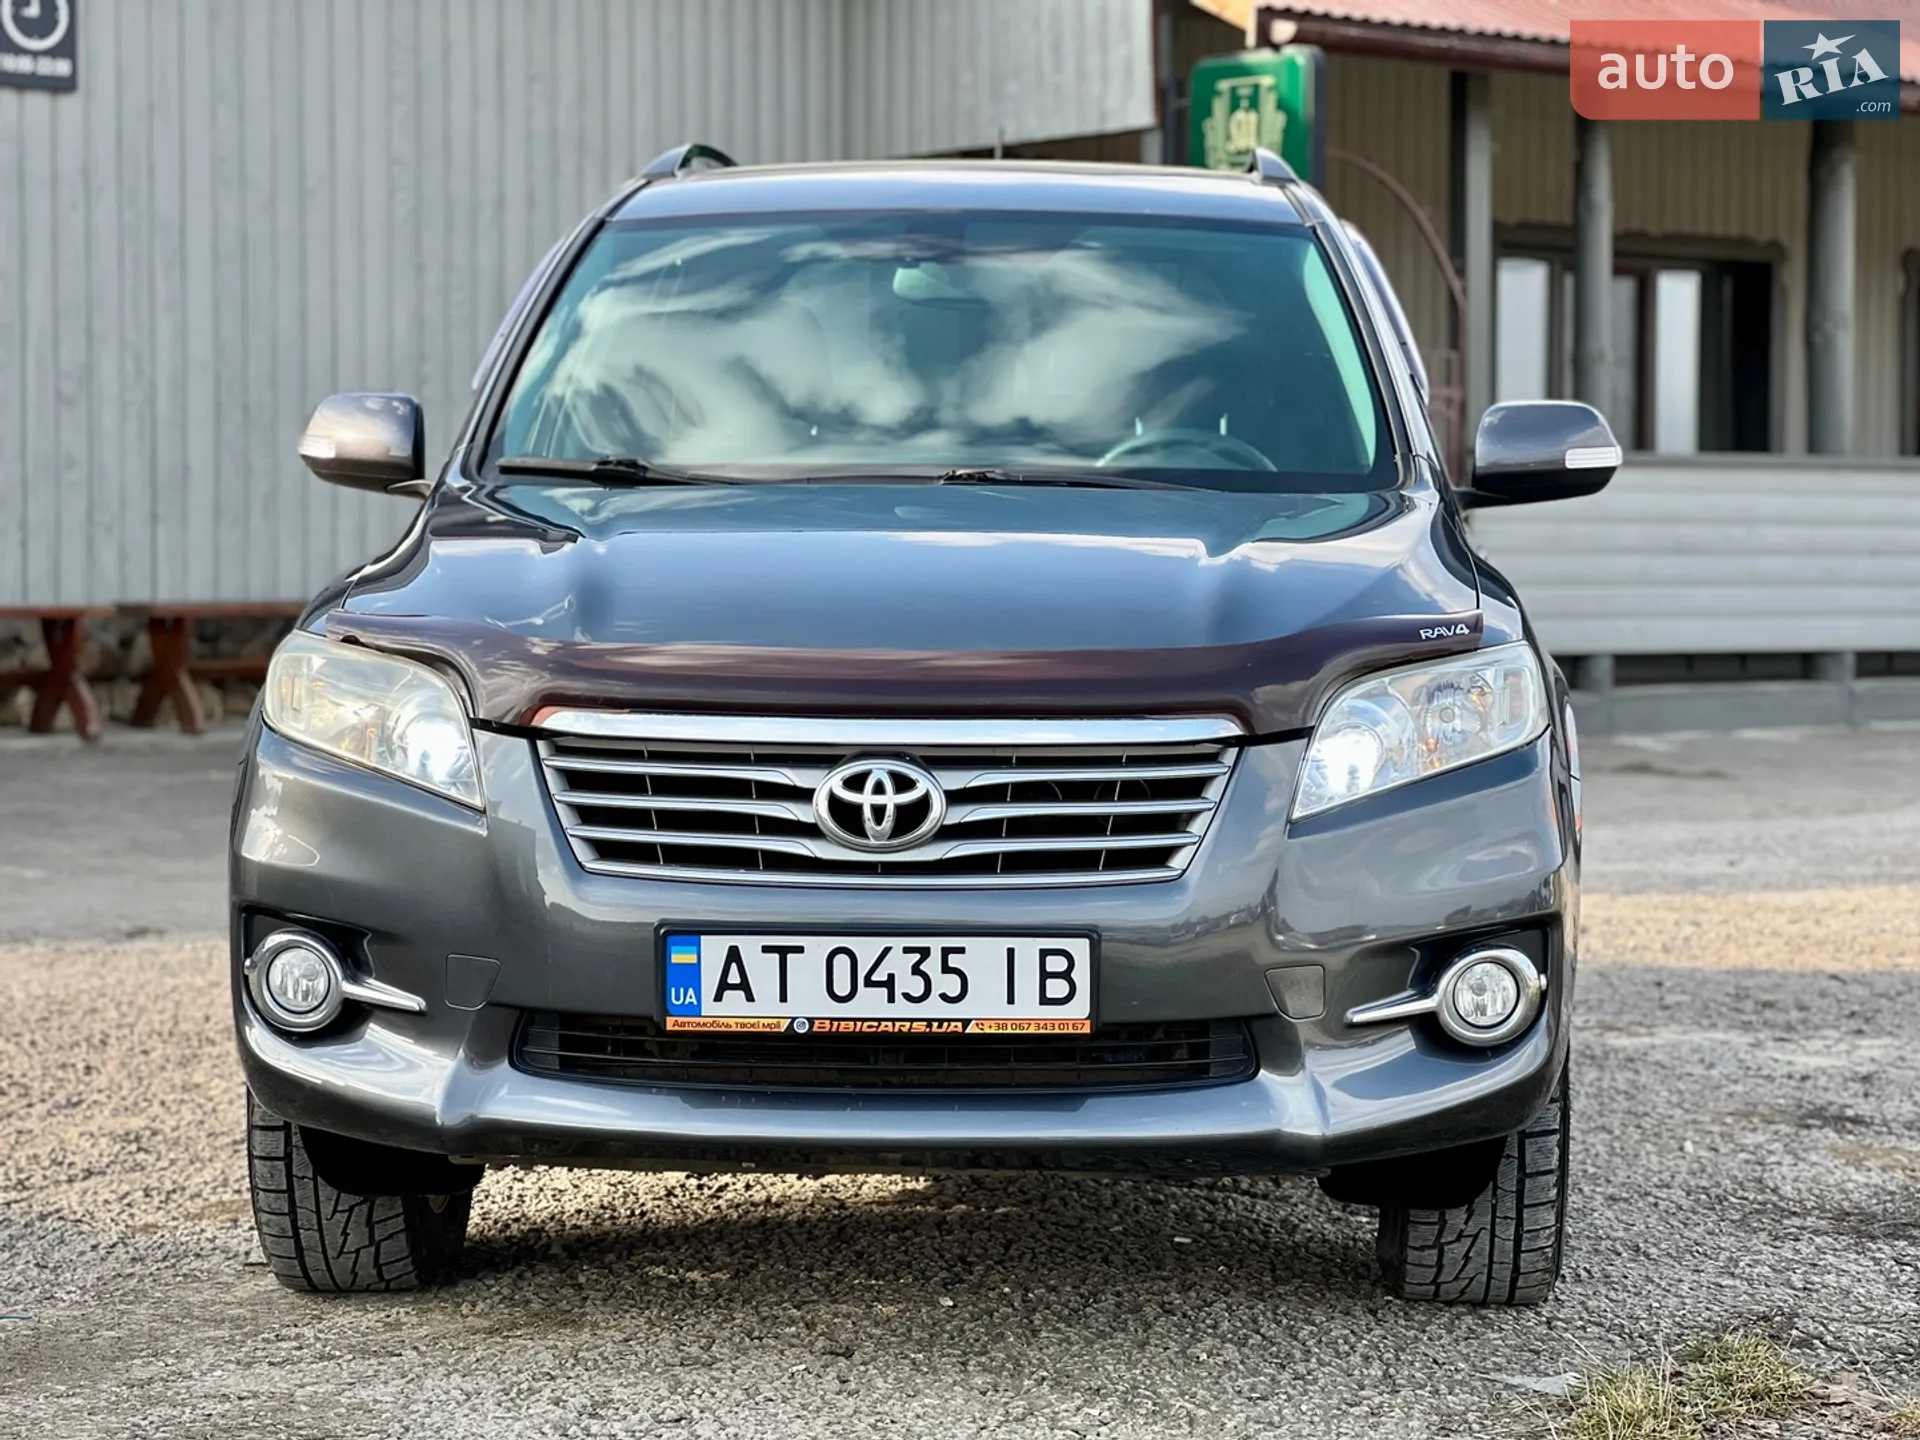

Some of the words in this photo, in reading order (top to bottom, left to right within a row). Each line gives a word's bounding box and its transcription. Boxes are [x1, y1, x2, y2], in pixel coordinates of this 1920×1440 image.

[1419, 623, 1470, 640] RAV4
[712, 944, 805, 1003] AT
[825, 945, 969, 1004] 0435
[1005, 946, 1078, 1006] IB
[671, 986, 698, 1006] UA
[672, 1018, 732, 1030] Автомобіль
[987, 1022, 1008, 1031] +38
[1010, 1022, 1031, 1031] 067
[1034, 1022, 1055, 1031] 343
[1071, 1022, 1086, 1031] 67
